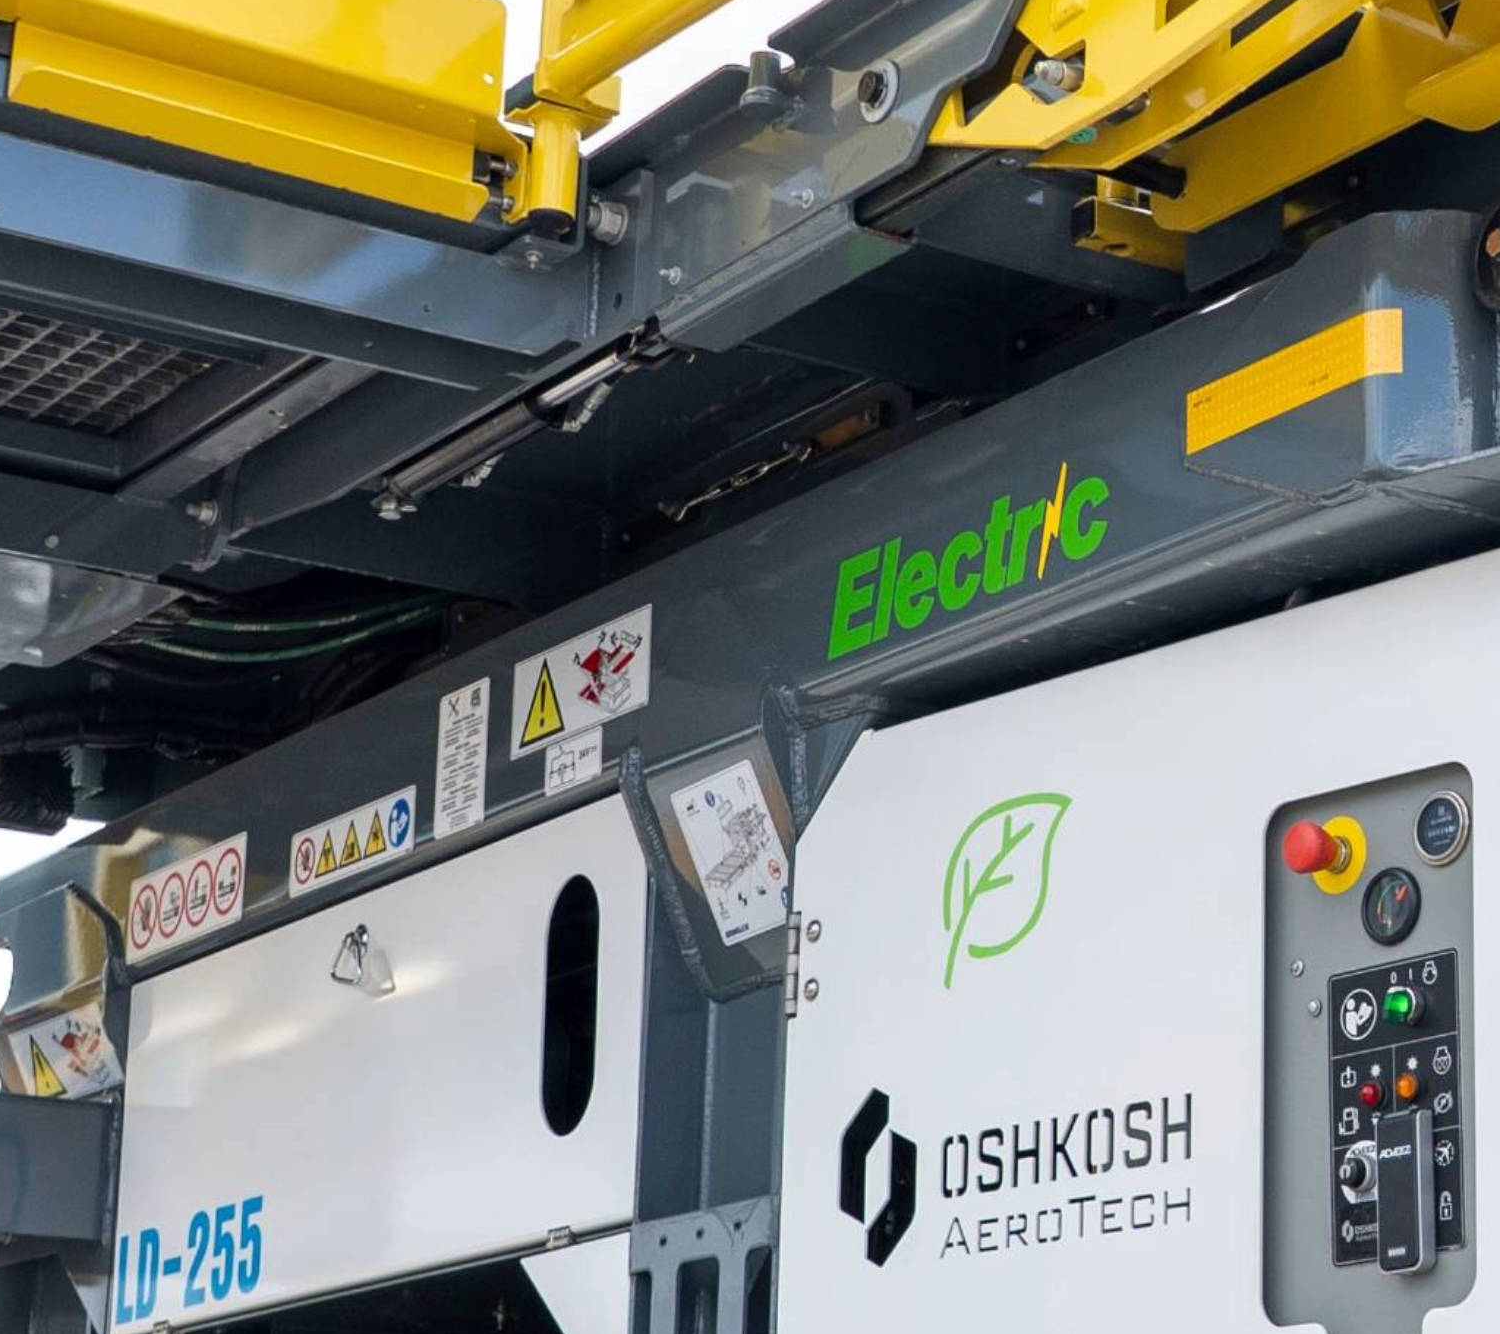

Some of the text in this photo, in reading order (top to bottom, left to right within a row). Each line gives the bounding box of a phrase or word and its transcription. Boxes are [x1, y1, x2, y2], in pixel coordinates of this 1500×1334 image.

[826, 461, 1110, 661] Electric
[942, 1093, 1192, 1198] OSHKOSH
[115, 1195, 263, 1325] LD-255
